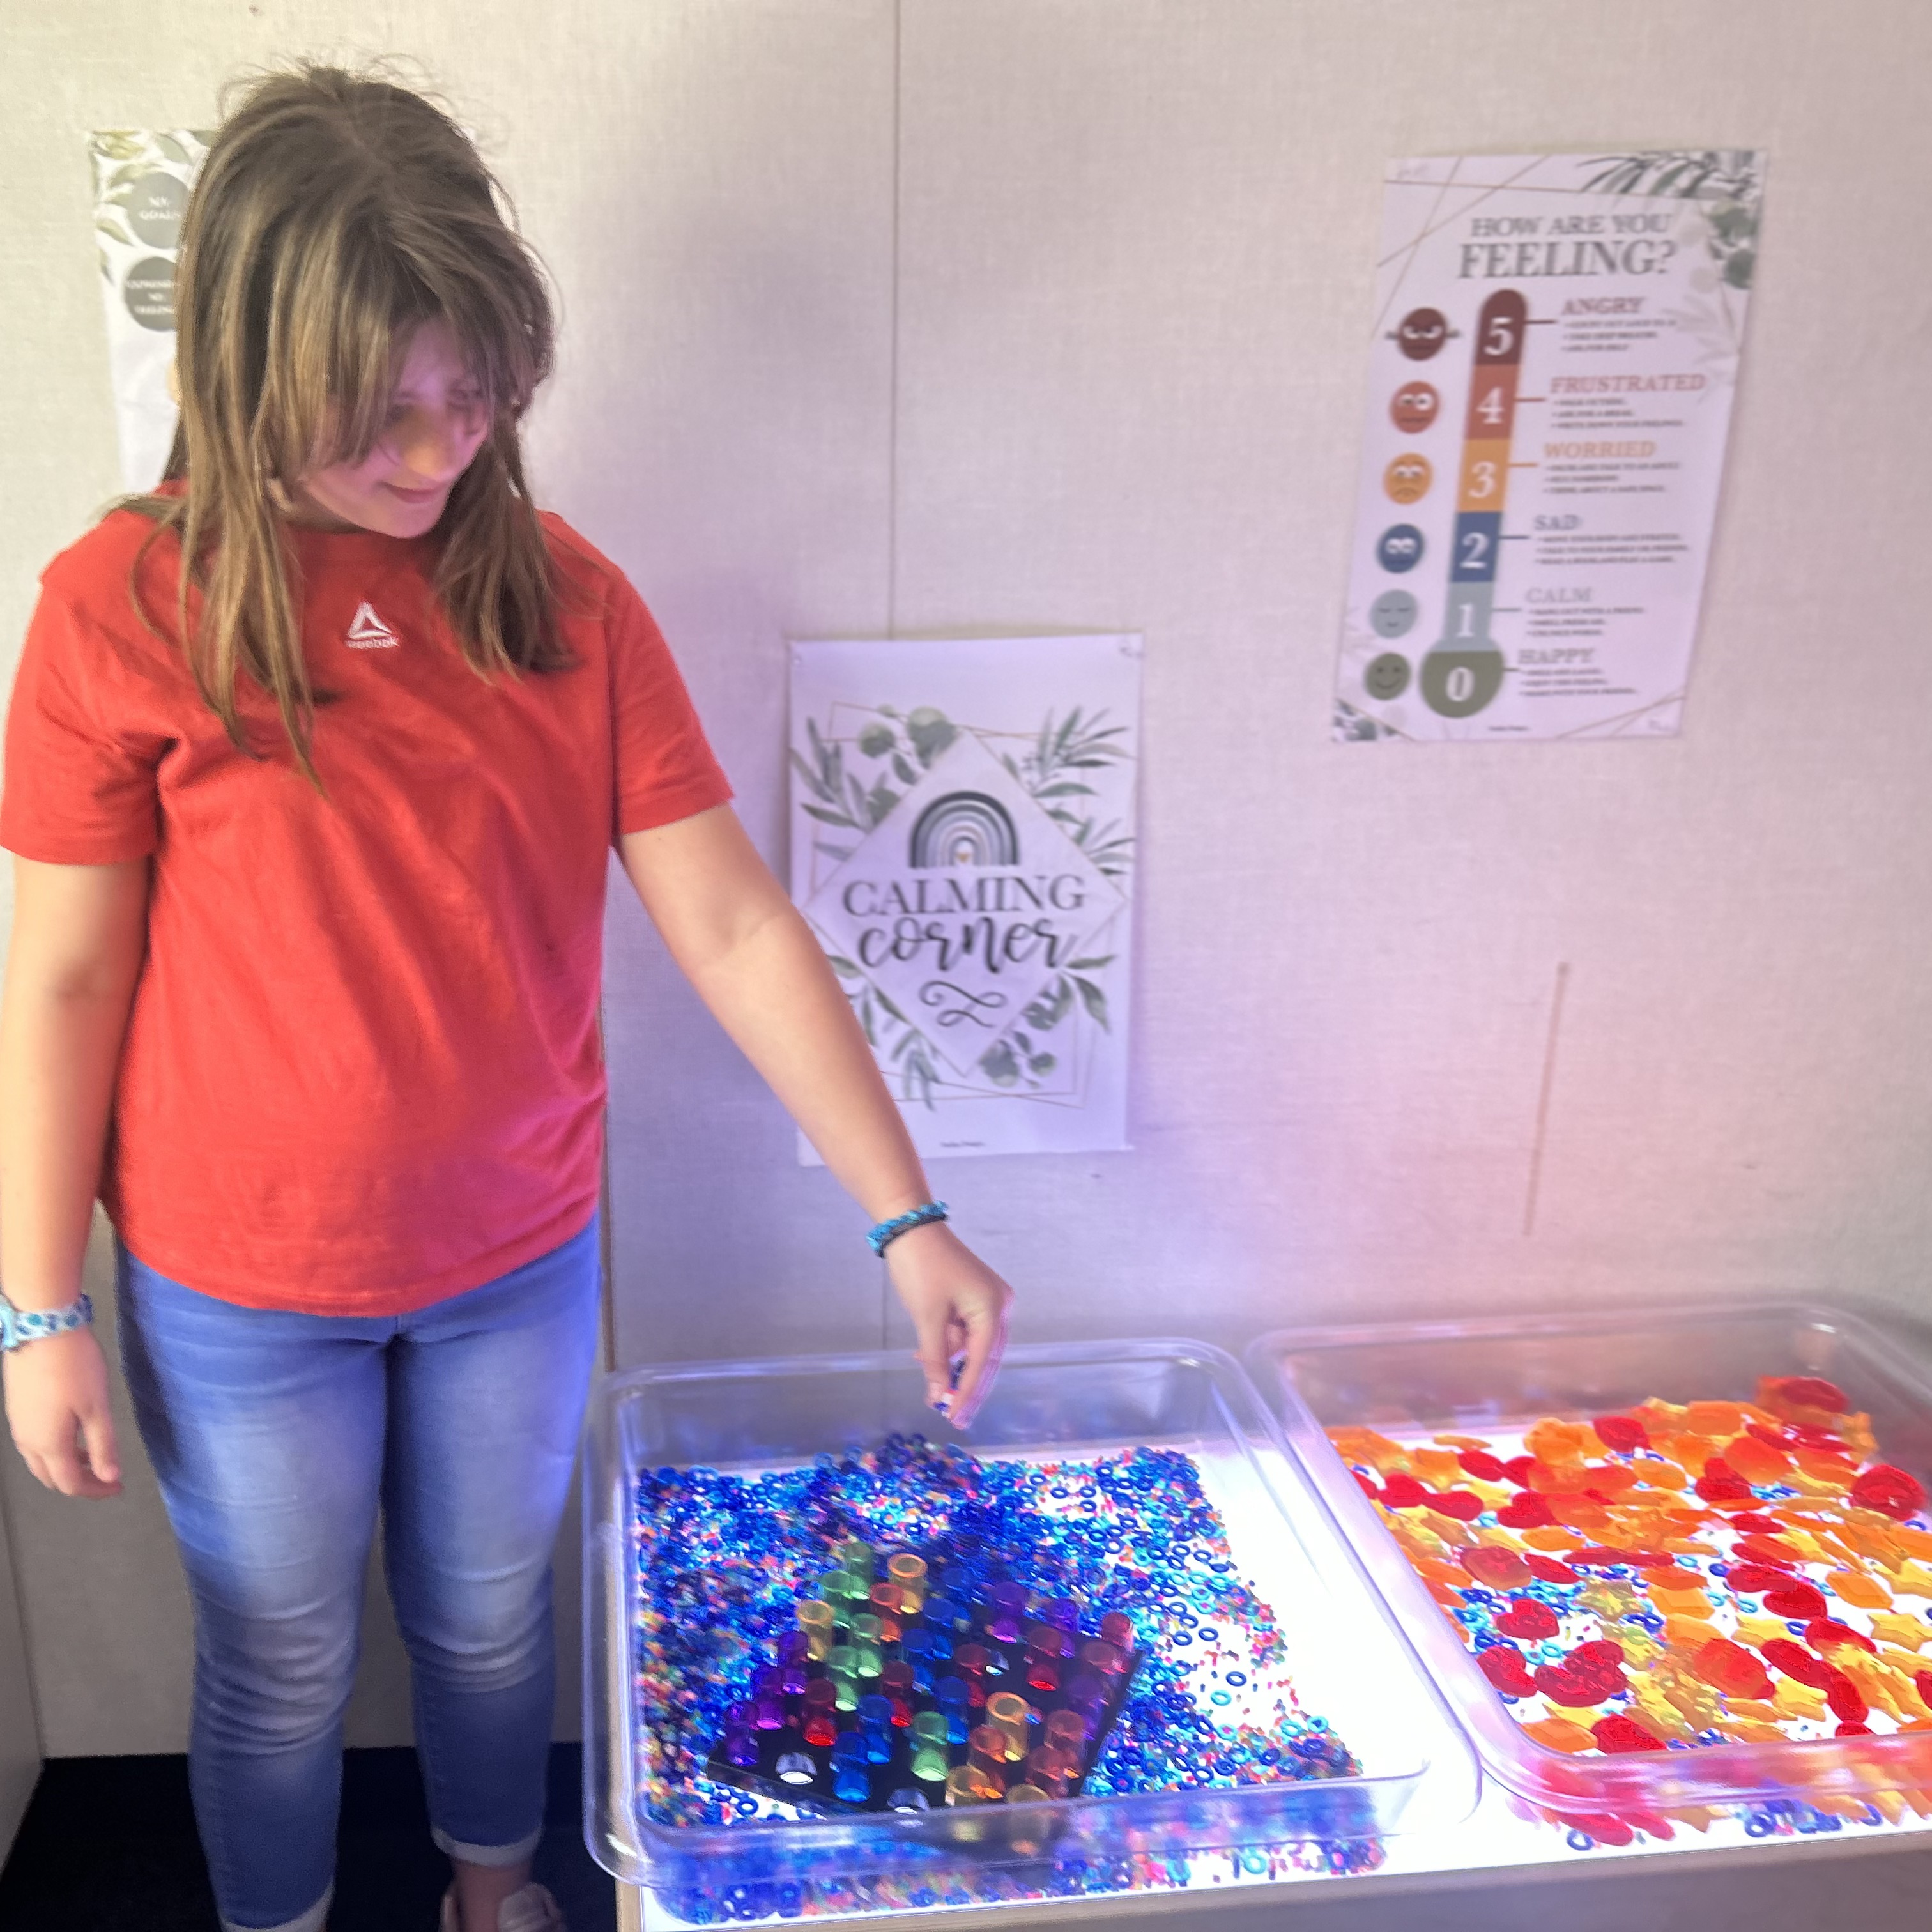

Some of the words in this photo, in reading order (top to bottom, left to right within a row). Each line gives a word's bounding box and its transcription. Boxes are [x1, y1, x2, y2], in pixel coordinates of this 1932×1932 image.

[1471, 216, 1543, 237] HOW
[1547, 214, 1603, 236] ARE
[1611, 213, 1673, 234] YOU
[1457, 239, 1679, 279] FEELING?
[1561, 296, 1646, 316] ANGRY
[1483, 316, 1514, 356] 5
[1550, 374, 1707, 394] FRUSTRATED
[1476, 387, 1505, 424] 4
[1544, 440, 1656, 459] WORRIED
[1469, 462, 1496, 498] 3
[1534, 515, 1581, 531] SAD
[1460, 533, 1491, 570] 2
[1525, 587, 1593, 604] CALM
[1457, 604, 1475, 638] 1
[1518, 648, 1595, 664] HAPPY
[1446, 668, 1475, 702] 0
[842, 874, 1086, 917] CALMING
[858, 917, 1075, 975] corner
